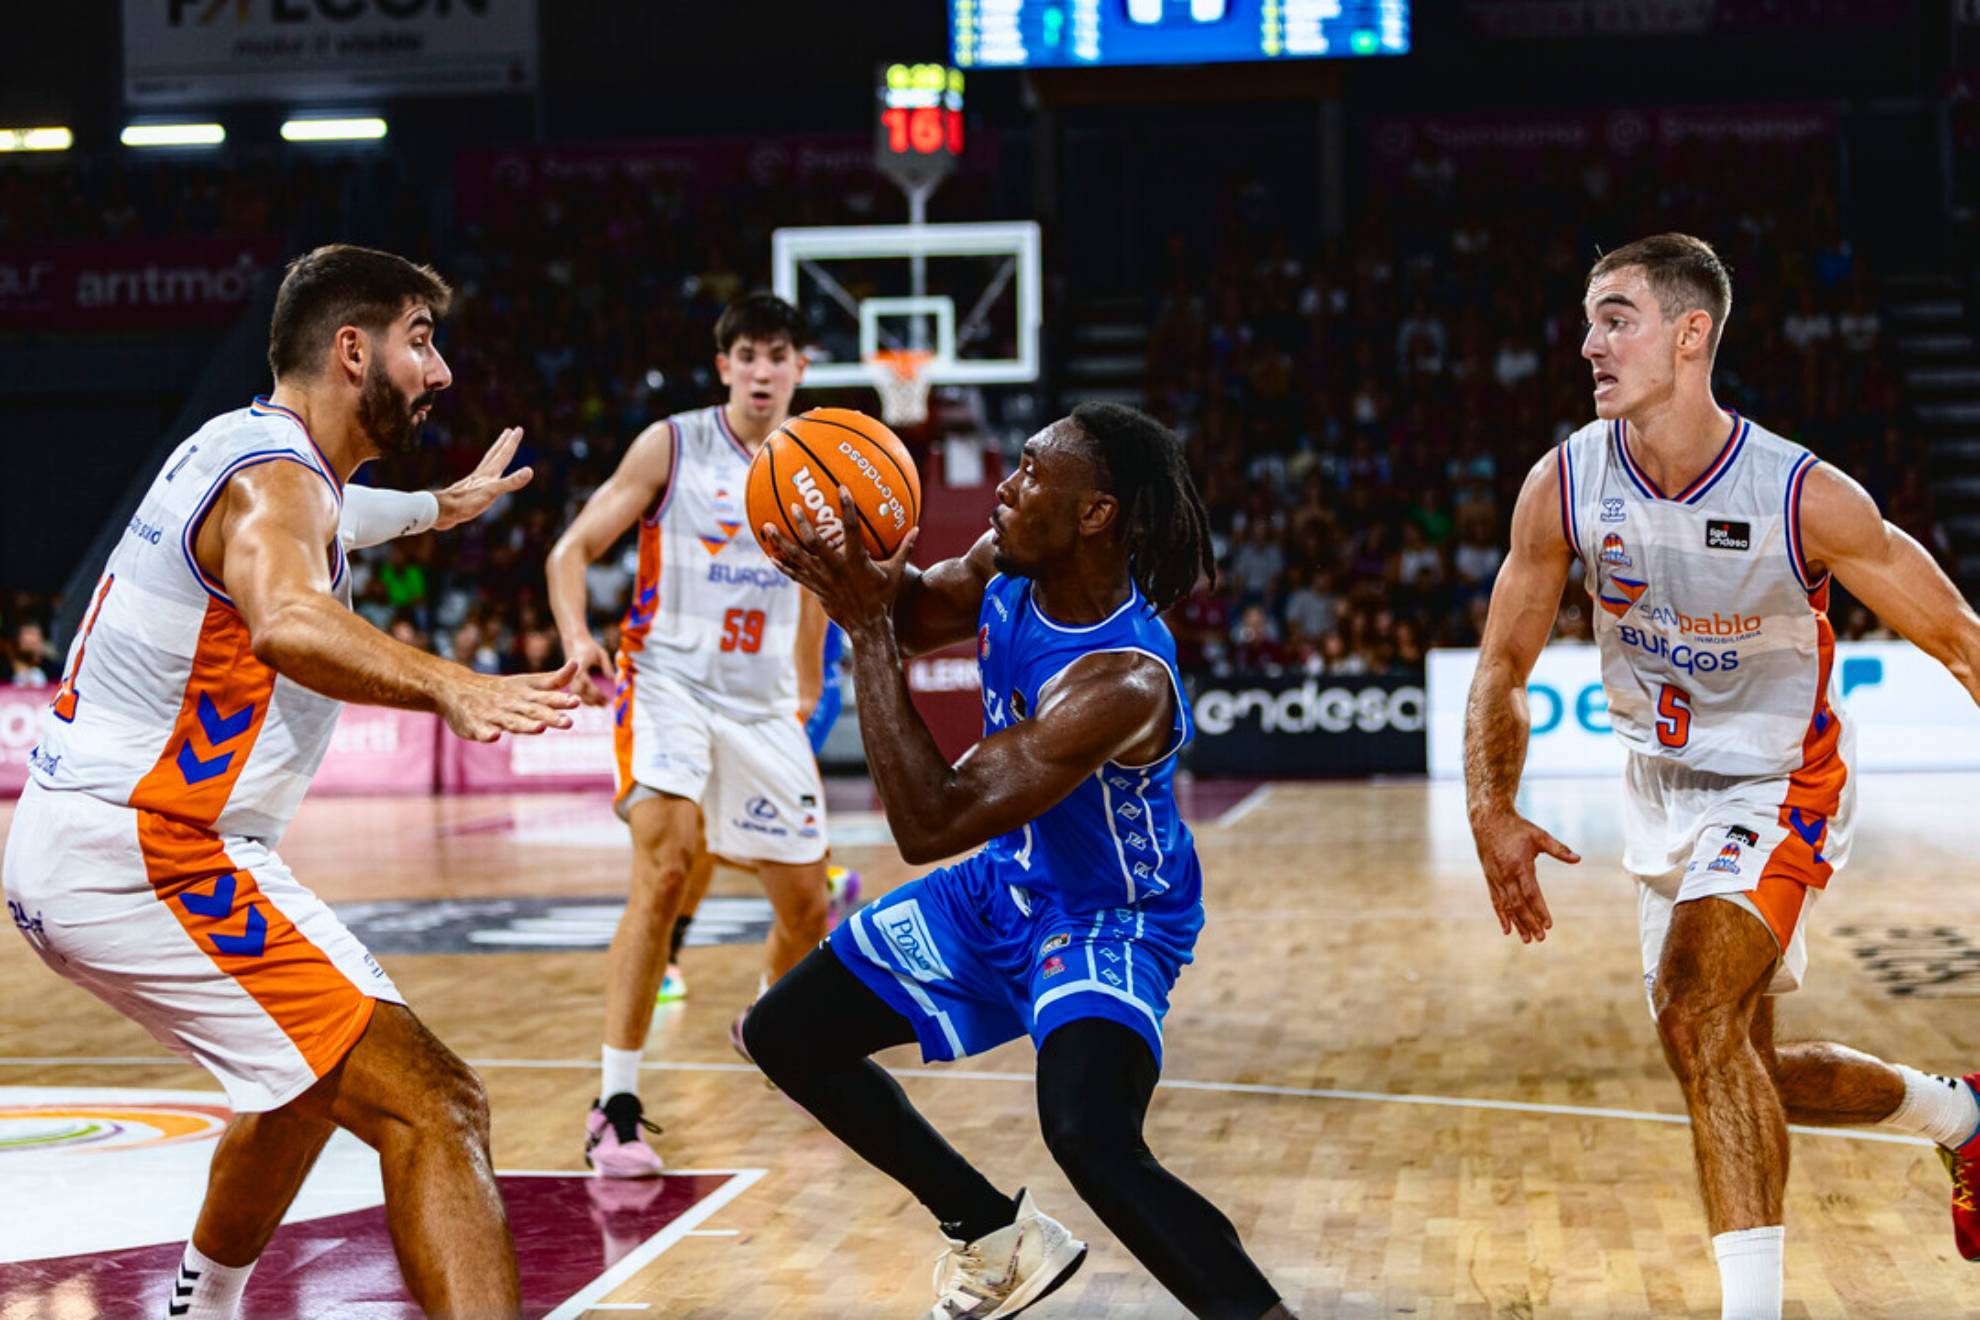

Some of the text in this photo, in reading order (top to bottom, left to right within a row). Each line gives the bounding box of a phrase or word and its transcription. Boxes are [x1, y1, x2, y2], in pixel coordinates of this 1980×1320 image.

[792, 466, 846, 548] ilson
[719, 607, 767, 654] 59
[1195, 681, 1427, 735] endesa
[1655, 683, 1692, 749] 5
